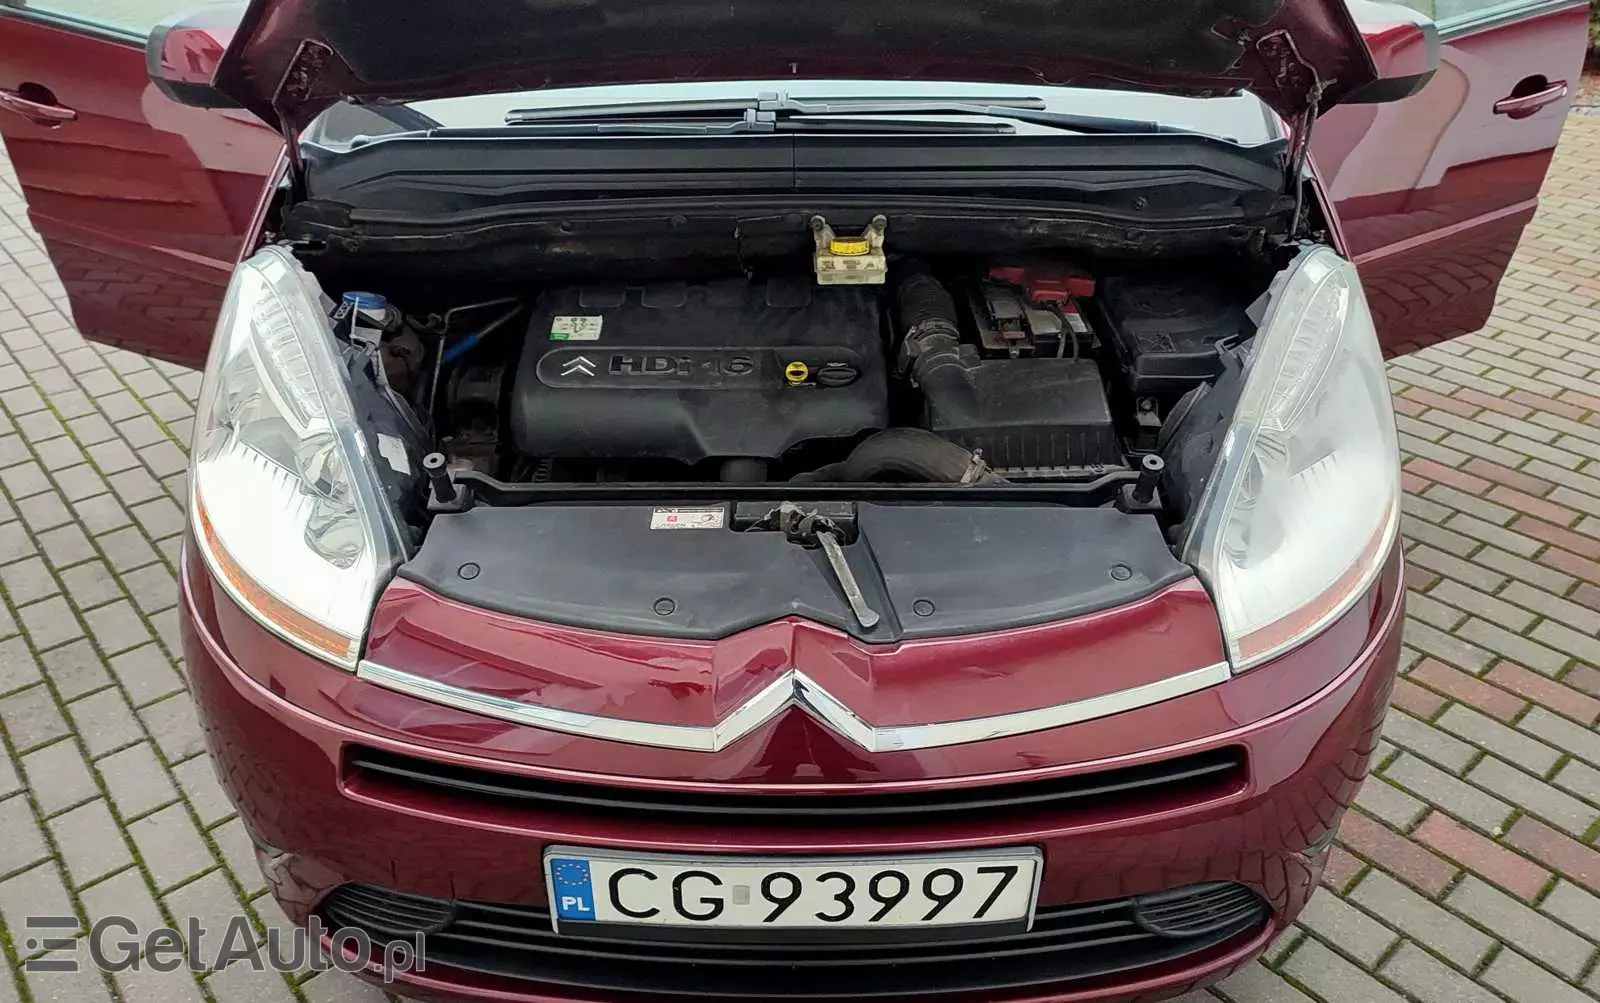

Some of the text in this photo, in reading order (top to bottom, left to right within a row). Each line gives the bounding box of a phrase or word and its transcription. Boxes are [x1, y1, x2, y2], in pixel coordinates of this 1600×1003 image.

[561, 896, 591, 912] PL
[607, 865, 1019, 923] CG 93997
